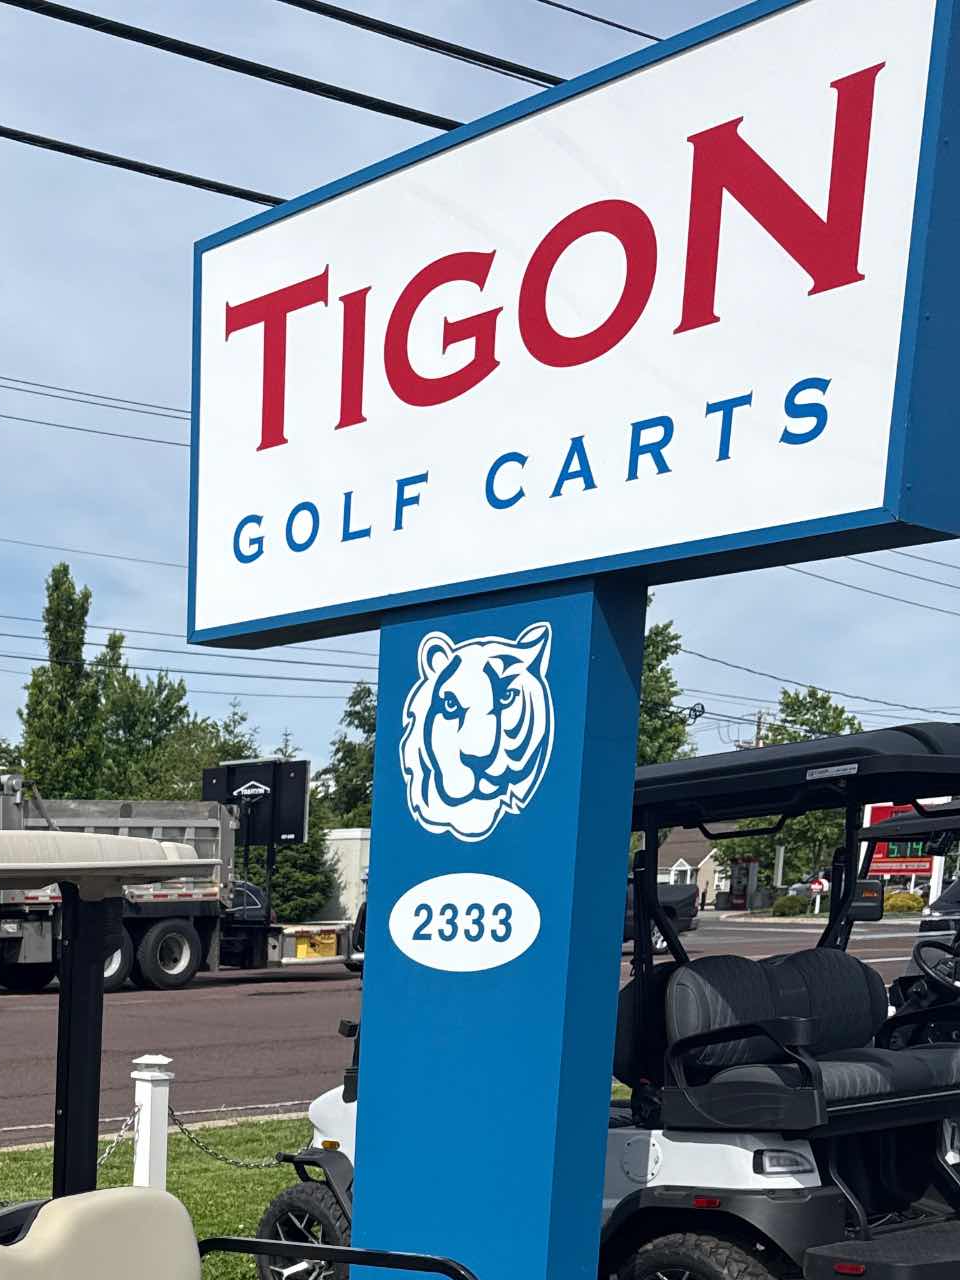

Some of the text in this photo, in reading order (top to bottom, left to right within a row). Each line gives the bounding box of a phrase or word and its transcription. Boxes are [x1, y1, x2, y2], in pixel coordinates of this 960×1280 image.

[225, 61, 886, 452] TIGON
[232, 377, 832, 565] GOLF CARTS
[412, 902, 512, 943] 2333
